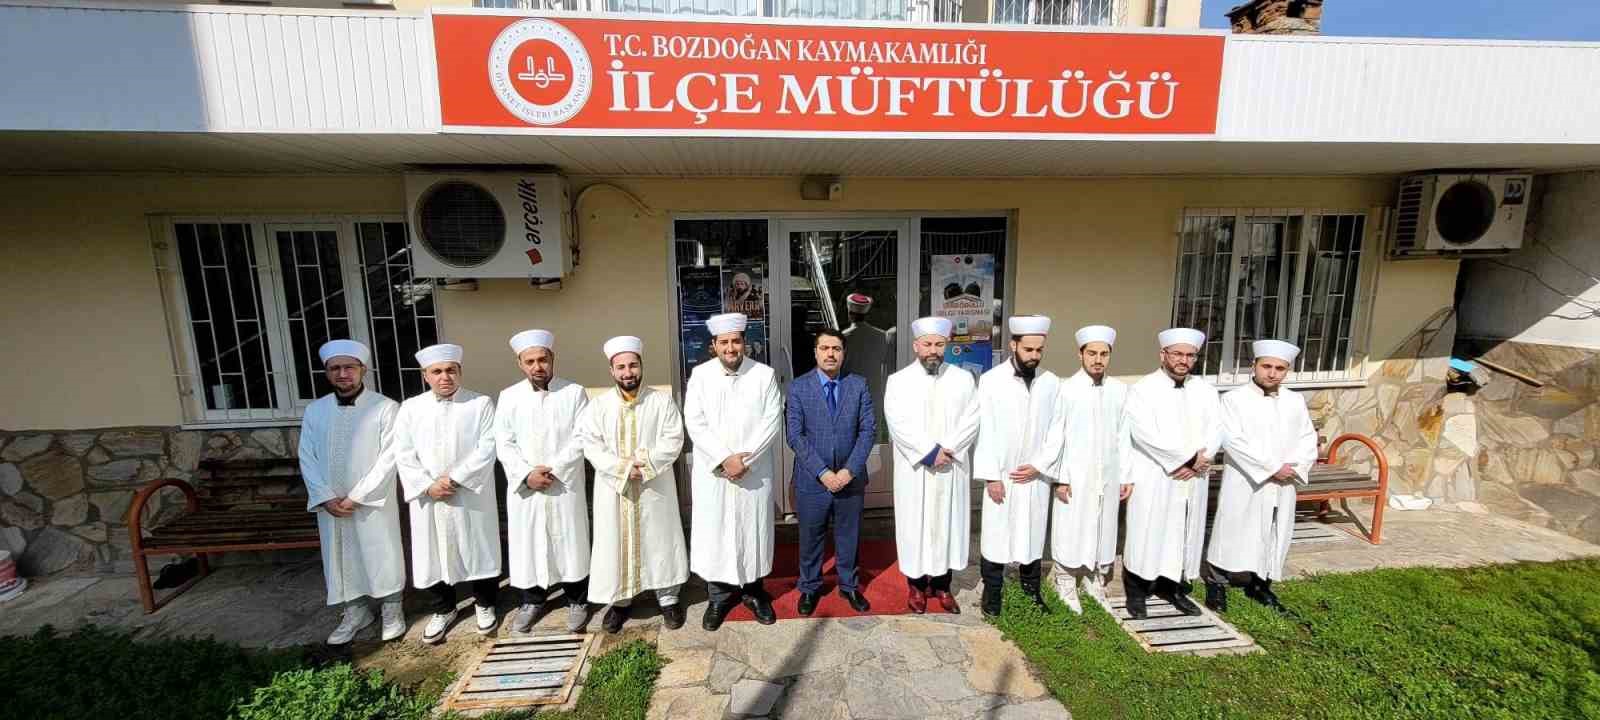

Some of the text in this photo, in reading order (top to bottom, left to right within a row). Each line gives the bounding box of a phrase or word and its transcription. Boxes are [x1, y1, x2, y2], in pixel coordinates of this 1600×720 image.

[604, 33, 987, 65] T.C. BOZDOĞAN KAYMAKAMLIĞI
[606, 59, 1181, 124] İLÇE MÜFTÜLÜĞÜ
[516, 178, 543, 245] arçelik
